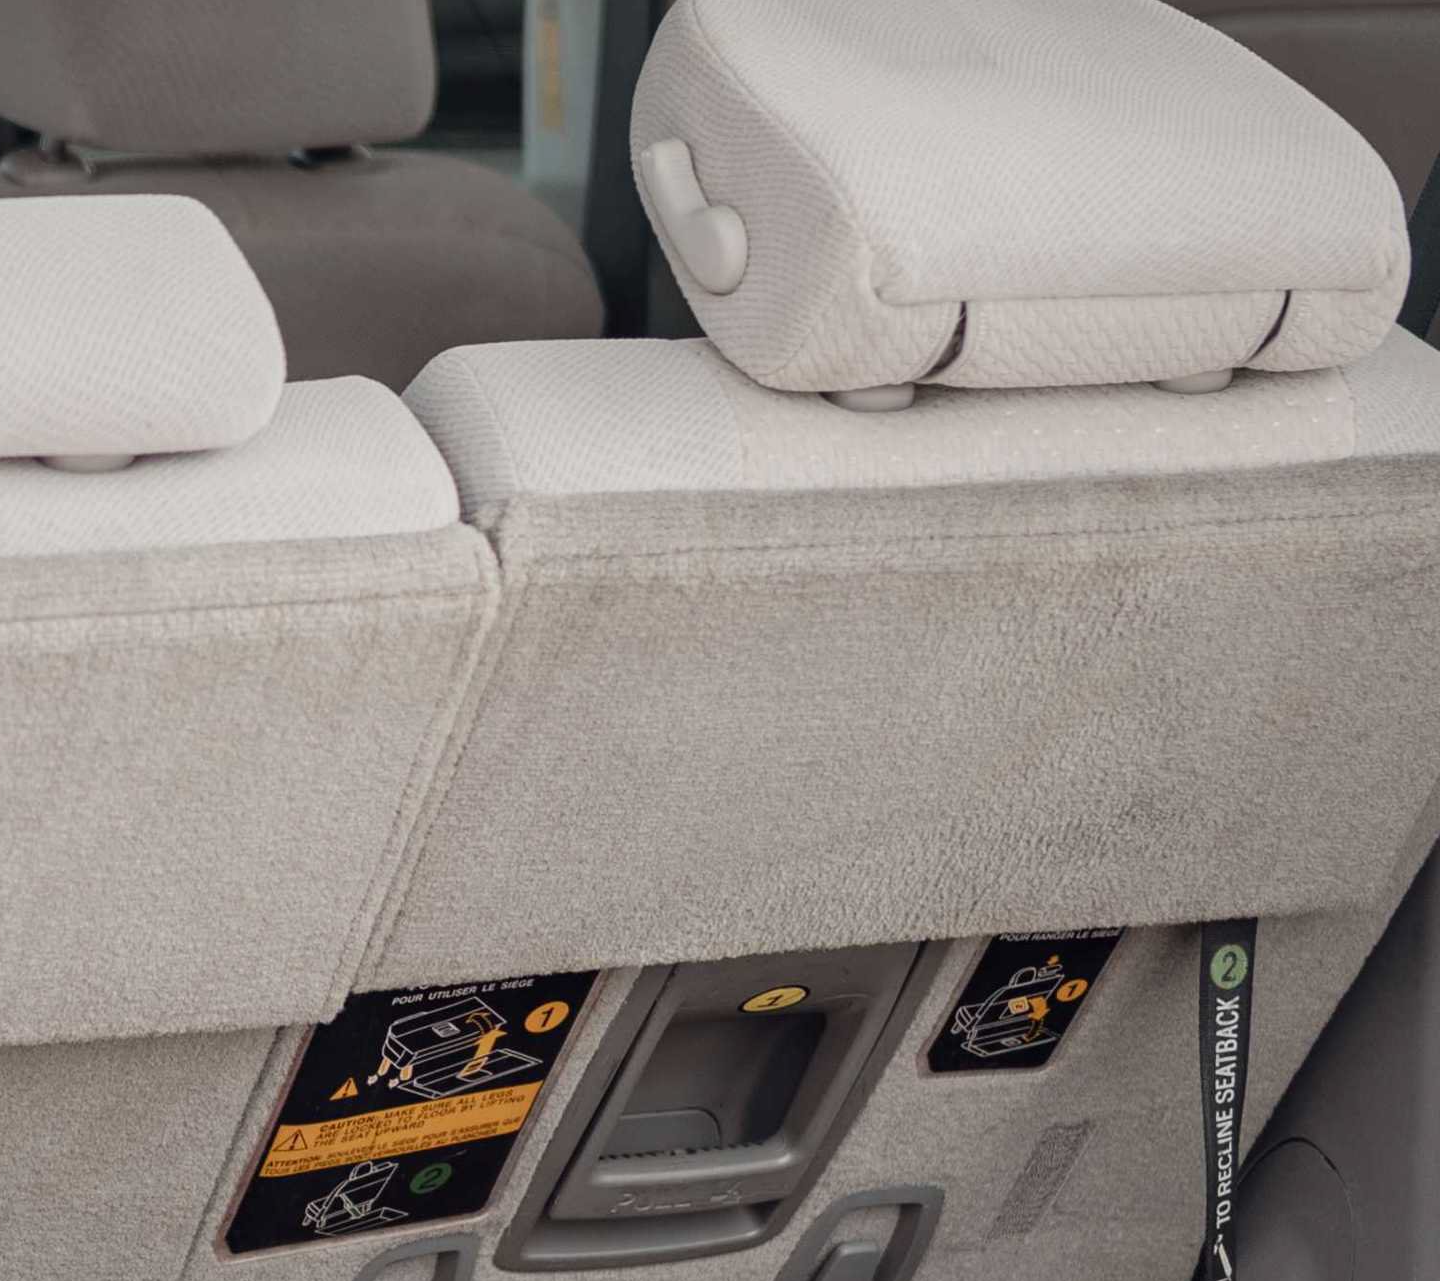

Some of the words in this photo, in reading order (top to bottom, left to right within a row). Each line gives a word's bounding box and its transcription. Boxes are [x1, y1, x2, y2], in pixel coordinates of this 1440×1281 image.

[999, 933, 1029, 942] POUR
[1076, 929, 1088, 937] LE
[1221, 951, 1238, 983] 2
[391, 994, 423, 1005] POUR
[428, 987, 476, 999] UTILISER
[482, 983, 496, 992] LE
[1215, 994, 1240, 1103] SEATBACK
[316, 1129, 340, 1139] ARE
[397, 1115, 411, 1124] TO
[479, 1094, 524, 1107] LIFTING
[384, 1108, 414, 1118] MAKE
[421, 1101, 450, 1111] SURE
[456, 1095, 475, 1105] ALL
[481, 1089, 512, 1100] LEGS
[314, 1137, 335, 1147] THE
[1216, 1106, 1234, 1190] RECLINE
[1216, 1192, 1231, 1229] TO
